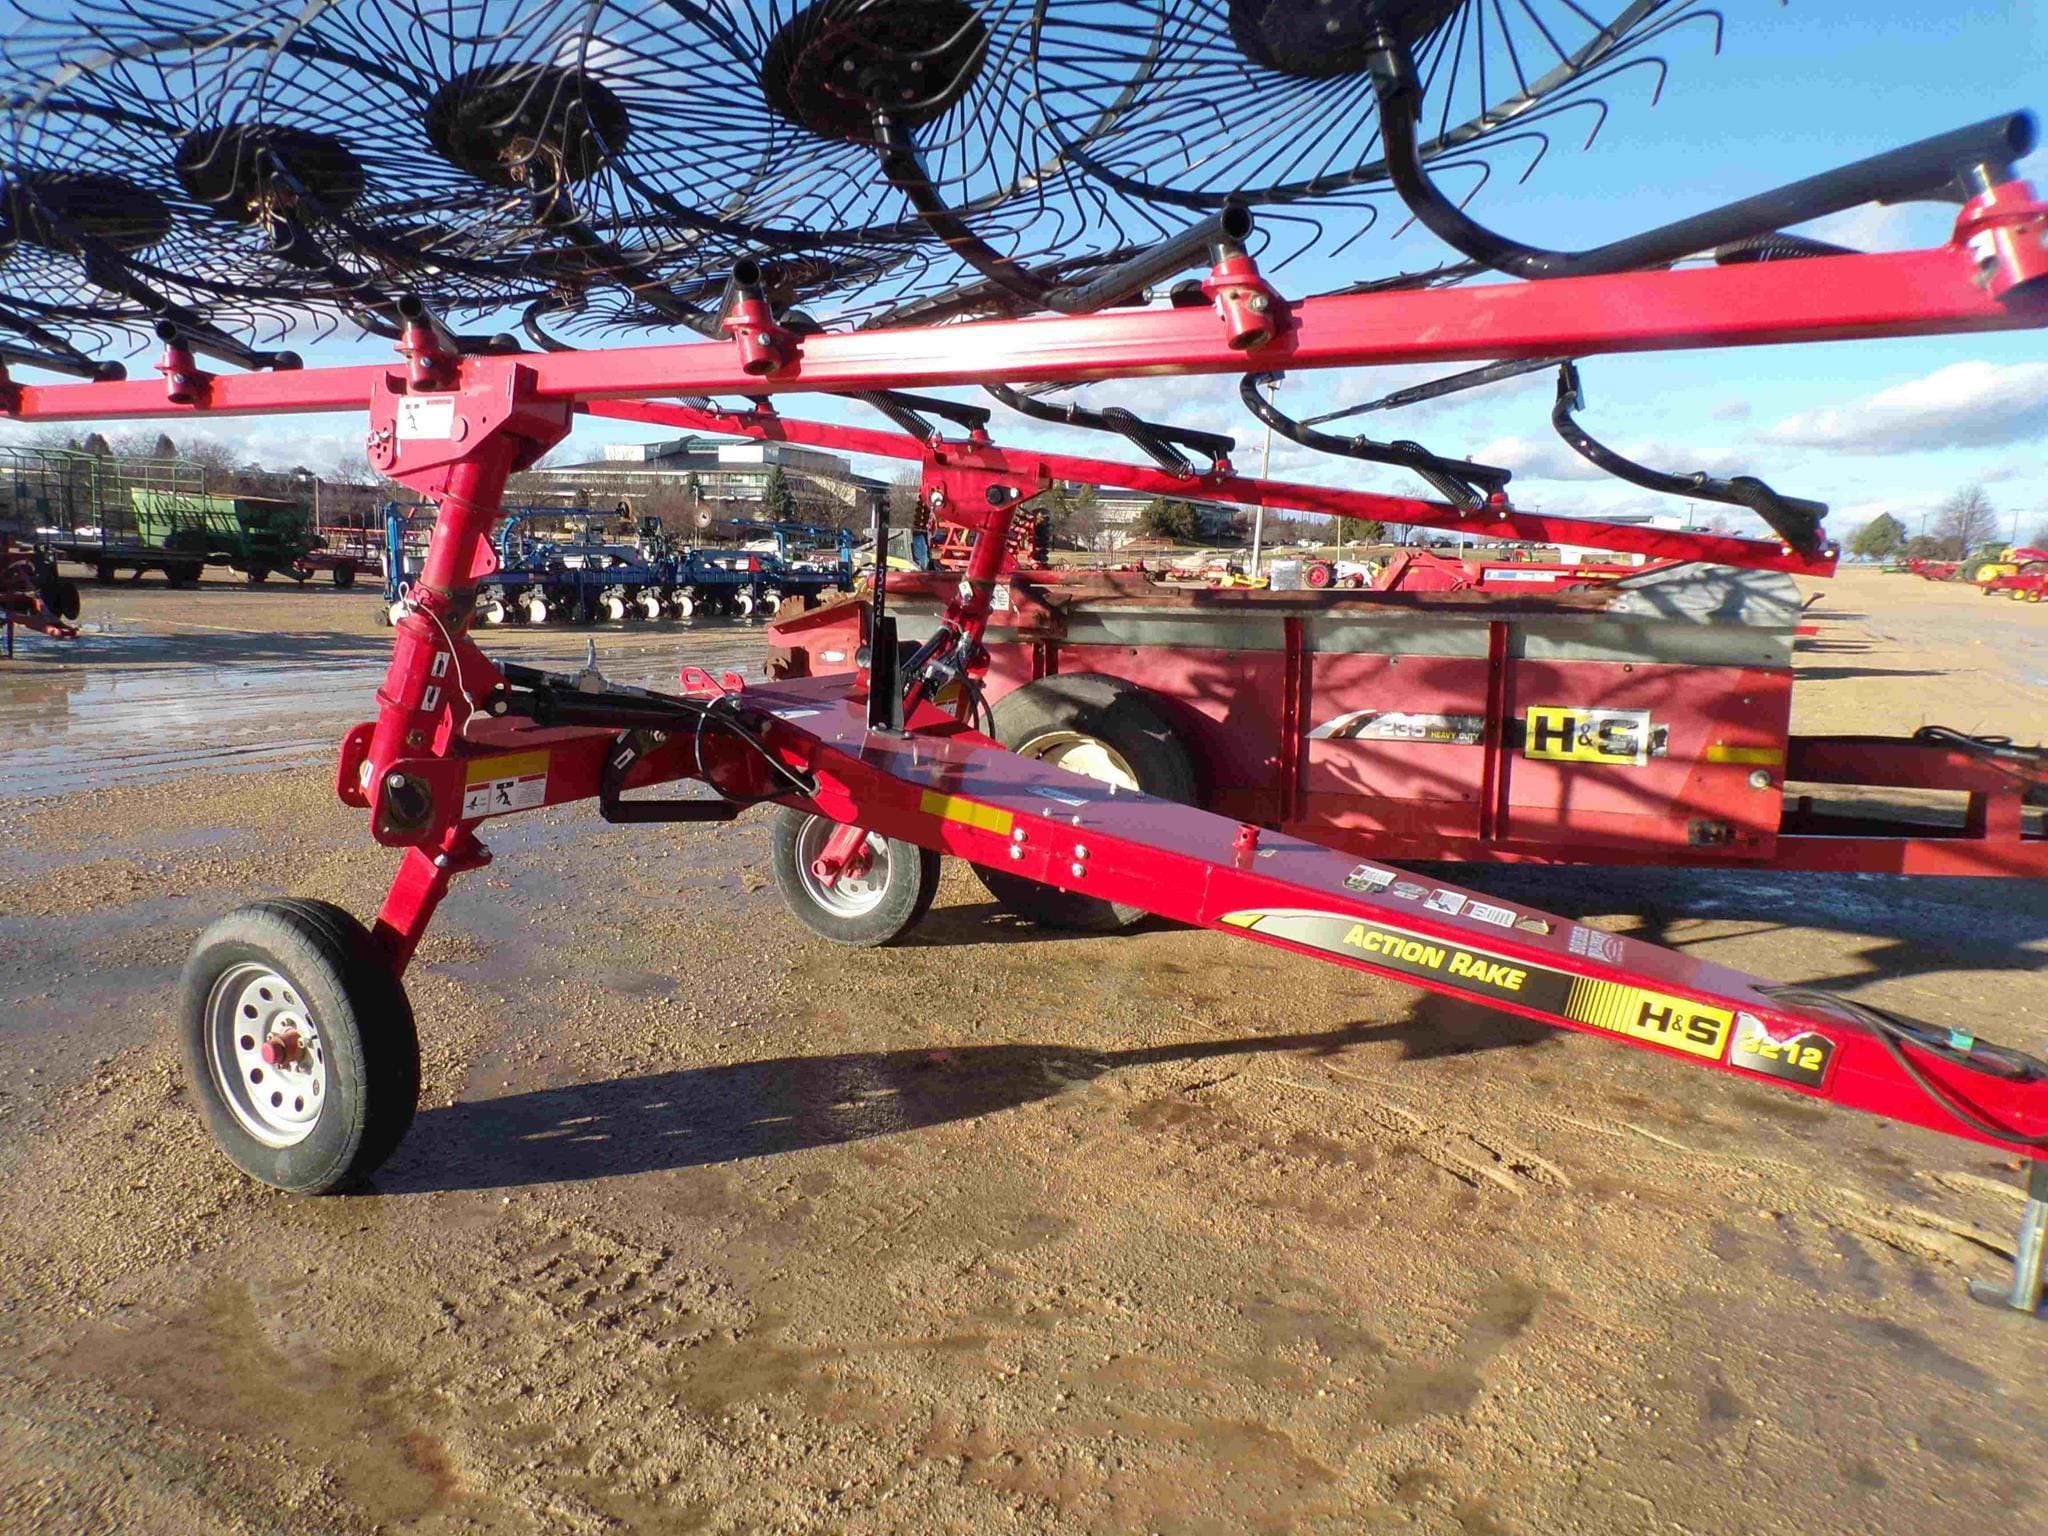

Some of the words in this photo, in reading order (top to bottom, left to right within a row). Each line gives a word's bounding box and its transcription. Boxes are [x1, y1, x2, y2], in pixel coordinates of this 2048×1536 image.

[1430, 731, 1457, 740] HEAVY
[1458, 732, 1480, 741] DUTY
[1534, 715, 1639, 757] H&S
[1343, 924, 1446, 969] ACTION
[1448, 952, 1527, 991] RAKE
[1637, 1001, 1721, 1046] H&S
